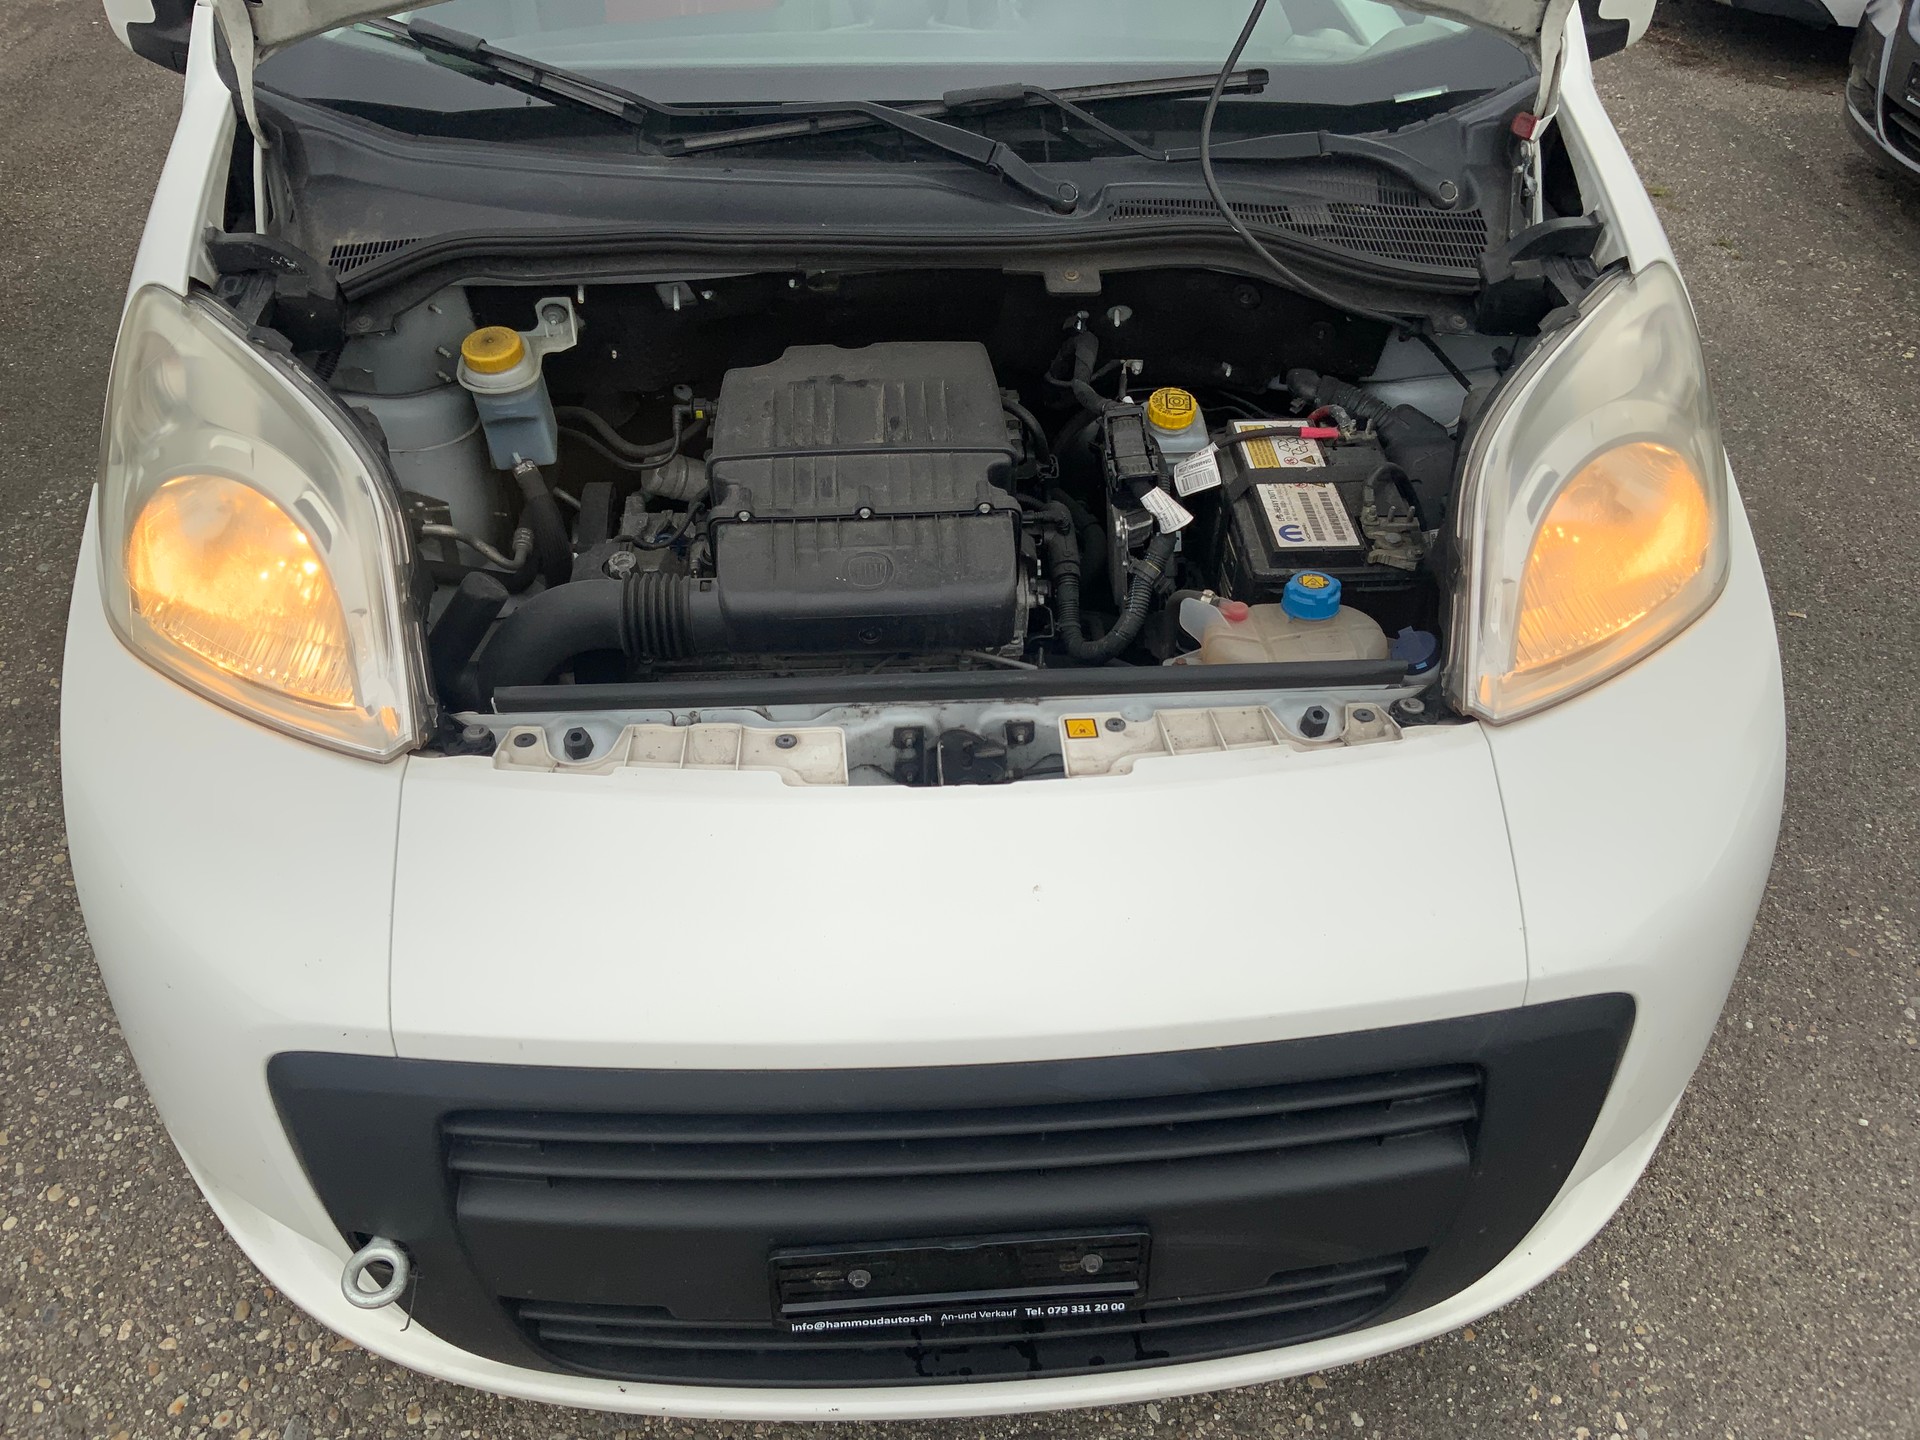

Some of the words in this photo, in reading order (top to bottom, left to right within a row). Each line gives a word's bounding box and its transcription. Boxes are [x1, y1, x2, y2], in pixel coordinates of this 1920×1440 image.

[940, 1311, 977, 1321] An-und
[979, 1308, 1018, 1319] Verkauf
[1025, 1307, 1045, 1316] Tel.
[1047, 1305, 1069, 1315] 079
[1071, 1304, 1092, 1314] 331
[1094, 1303, 1108, 1312] 20
[1110, 1302, 1126, 1311] 00
